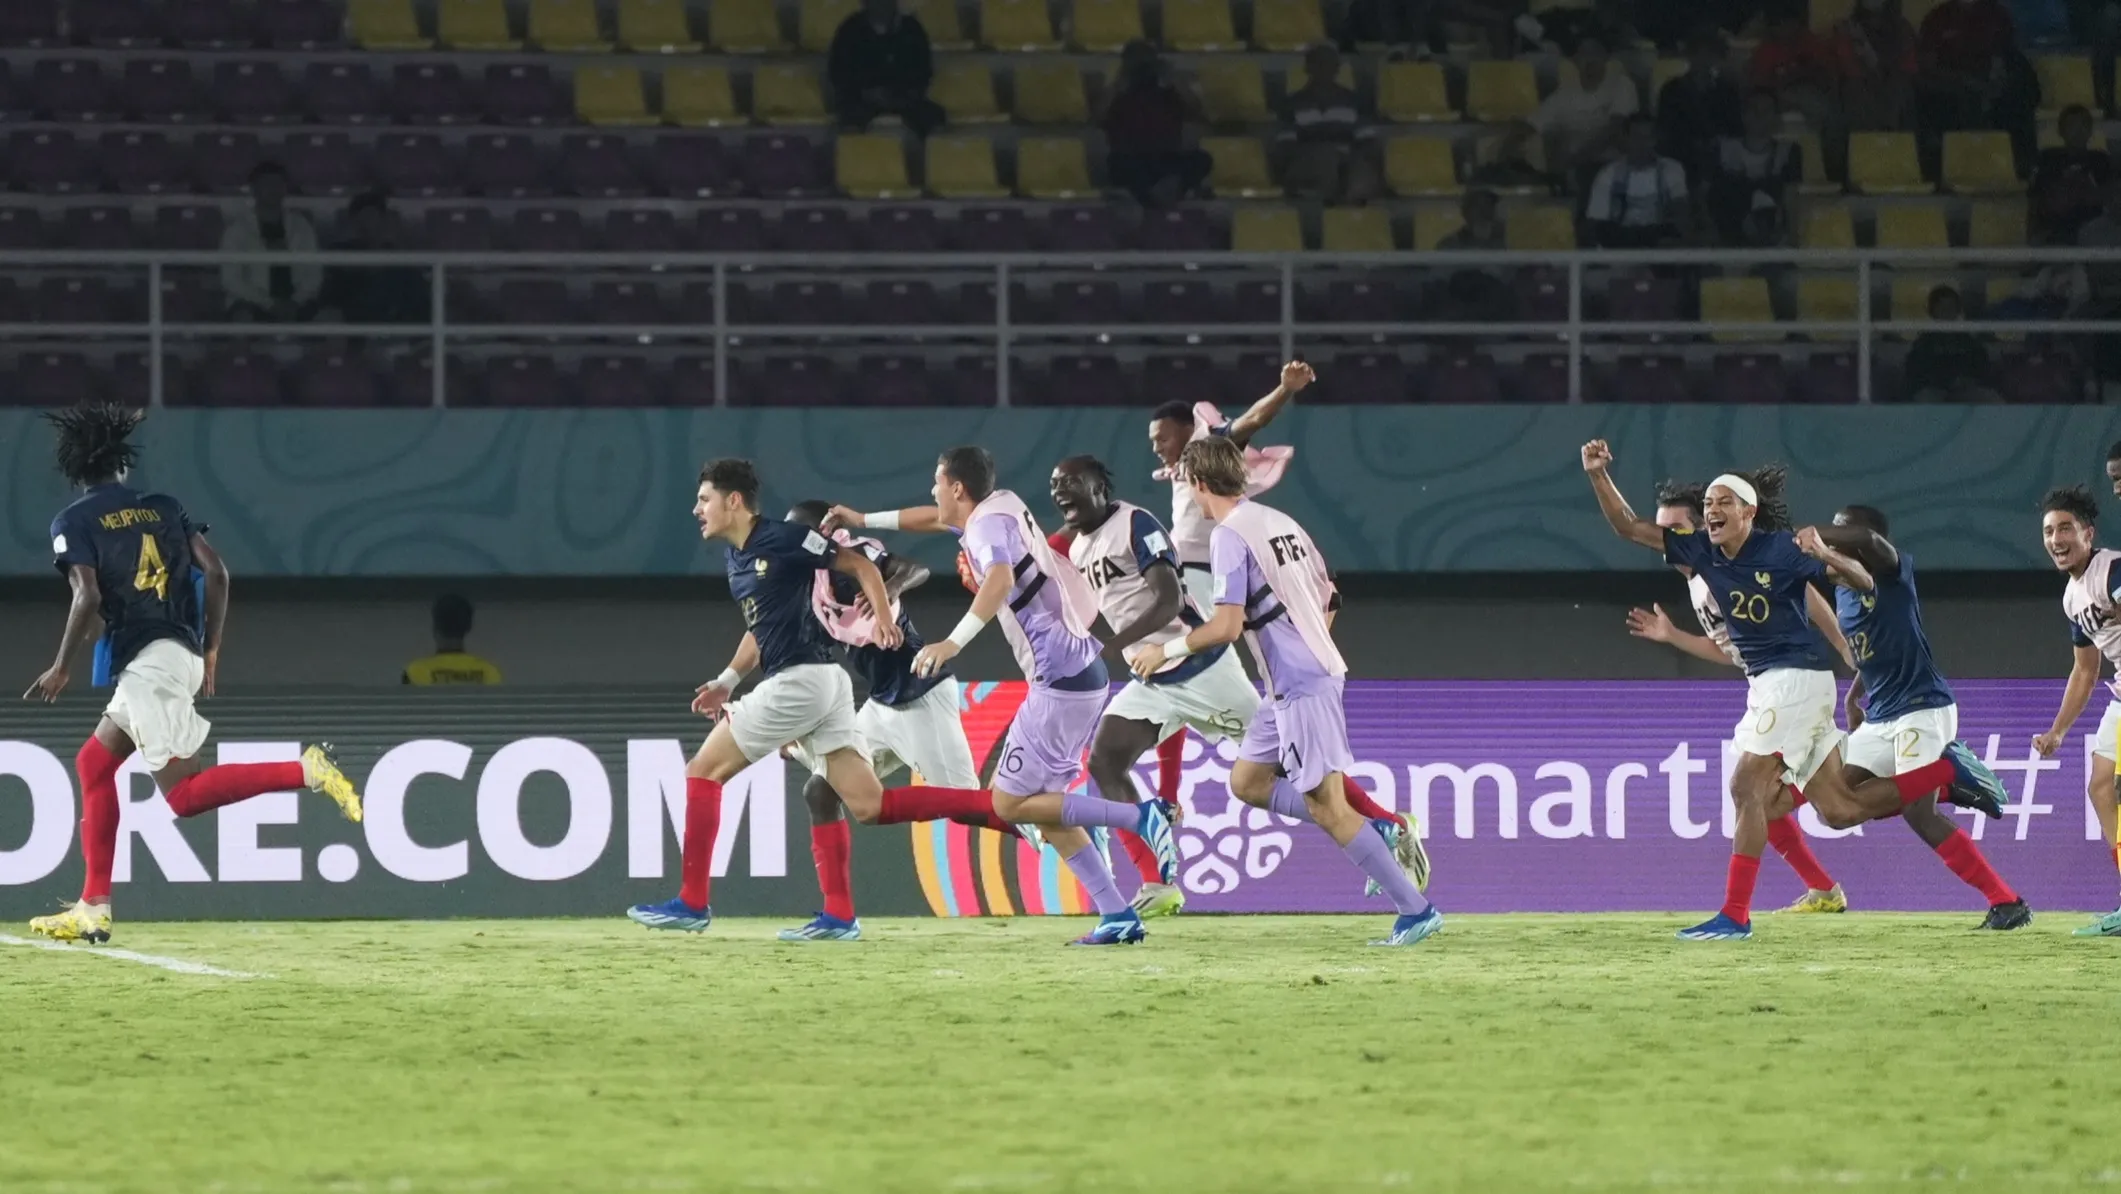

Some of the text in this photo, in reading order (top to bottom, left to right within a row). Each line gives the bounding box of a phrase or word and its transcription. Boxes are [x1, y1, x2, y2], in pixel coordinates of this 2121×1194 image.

[134, 533, 169, 601] 4
[1268, 534, 1307, 567] FIF
[1729, 590, 1770, 623] 20
[1000, 741, 1024, 774] 16
[0, 737, 787, 885] ORE.COM
[1340, 740, 1864, 840] amart
